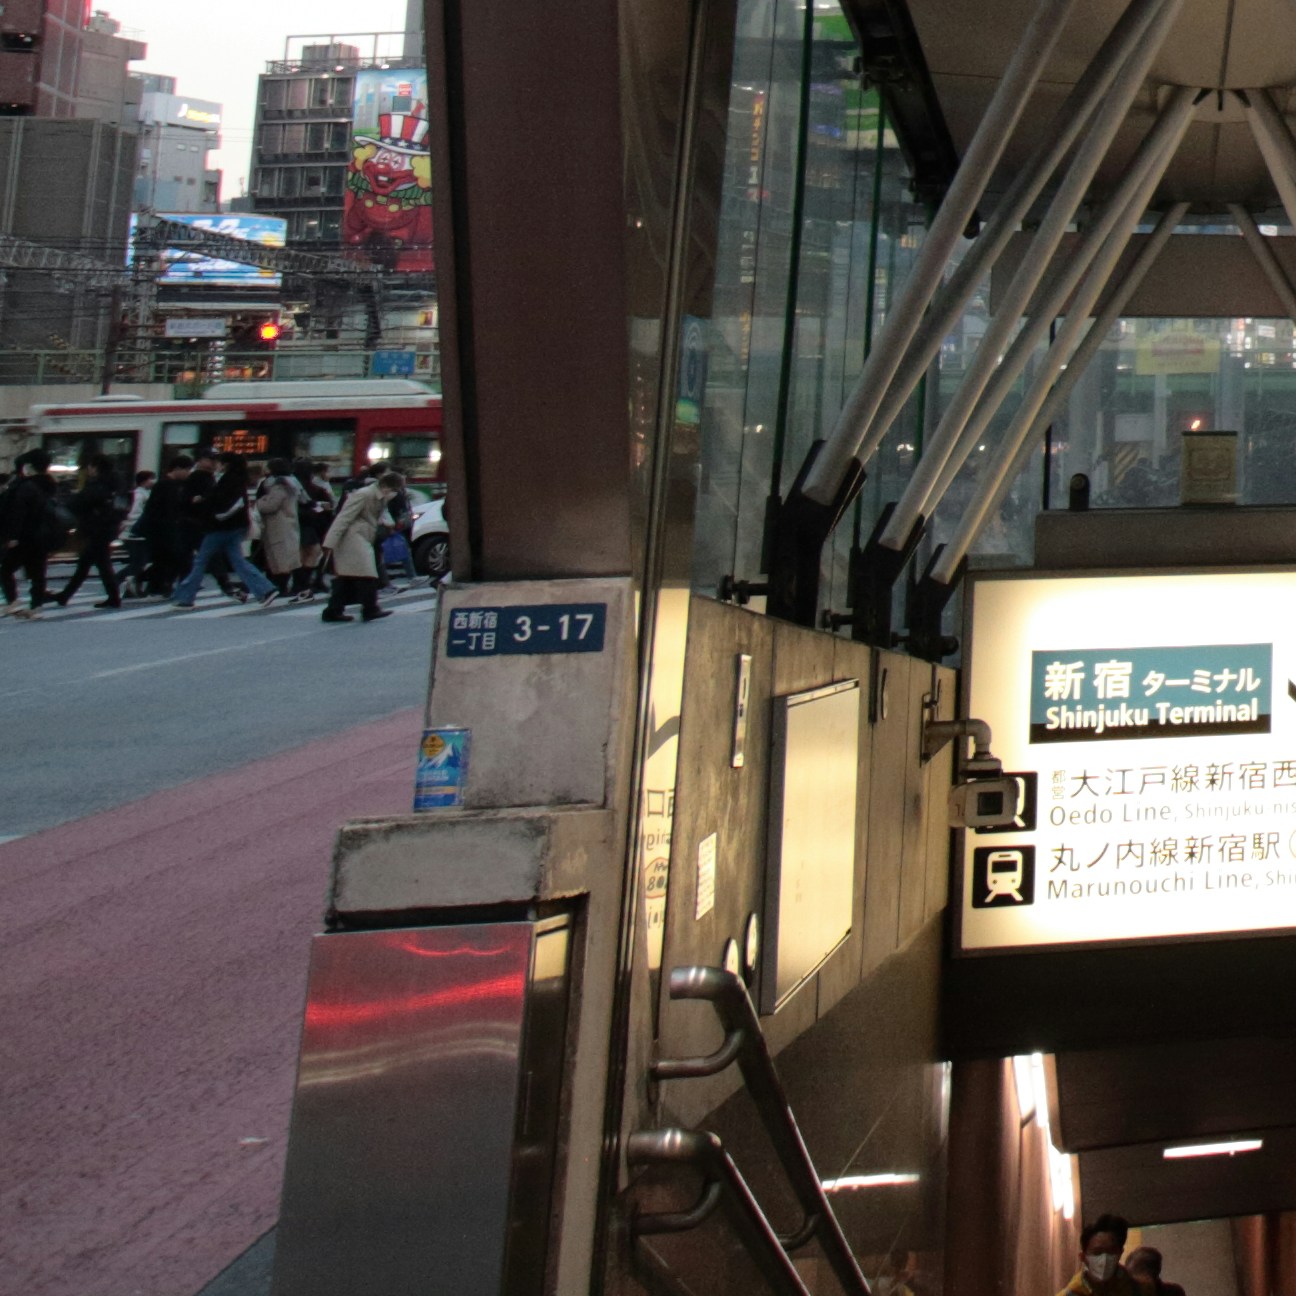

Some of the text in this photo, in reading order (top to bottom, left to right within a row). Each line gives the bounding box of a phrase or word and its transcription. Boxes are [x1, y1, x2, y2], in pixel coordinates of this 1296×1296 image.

[453, 611, 499, 630] 西新宿
[513, 613, 594, 642] 3-17
[452, 632, 496, 651] 一丁目
[1045, 697, 1259, 734] Shinjuku Terminal
[1049, 803, 1113, 828] Oedo
[1122, 801, 1178, 824] Line,
[1049, 831, 1281, 874] 丸ノ内線新宿駅
[1047, 874, 1195, 900] Marunouchi
[1204, 869, 1260, 892] Line,
